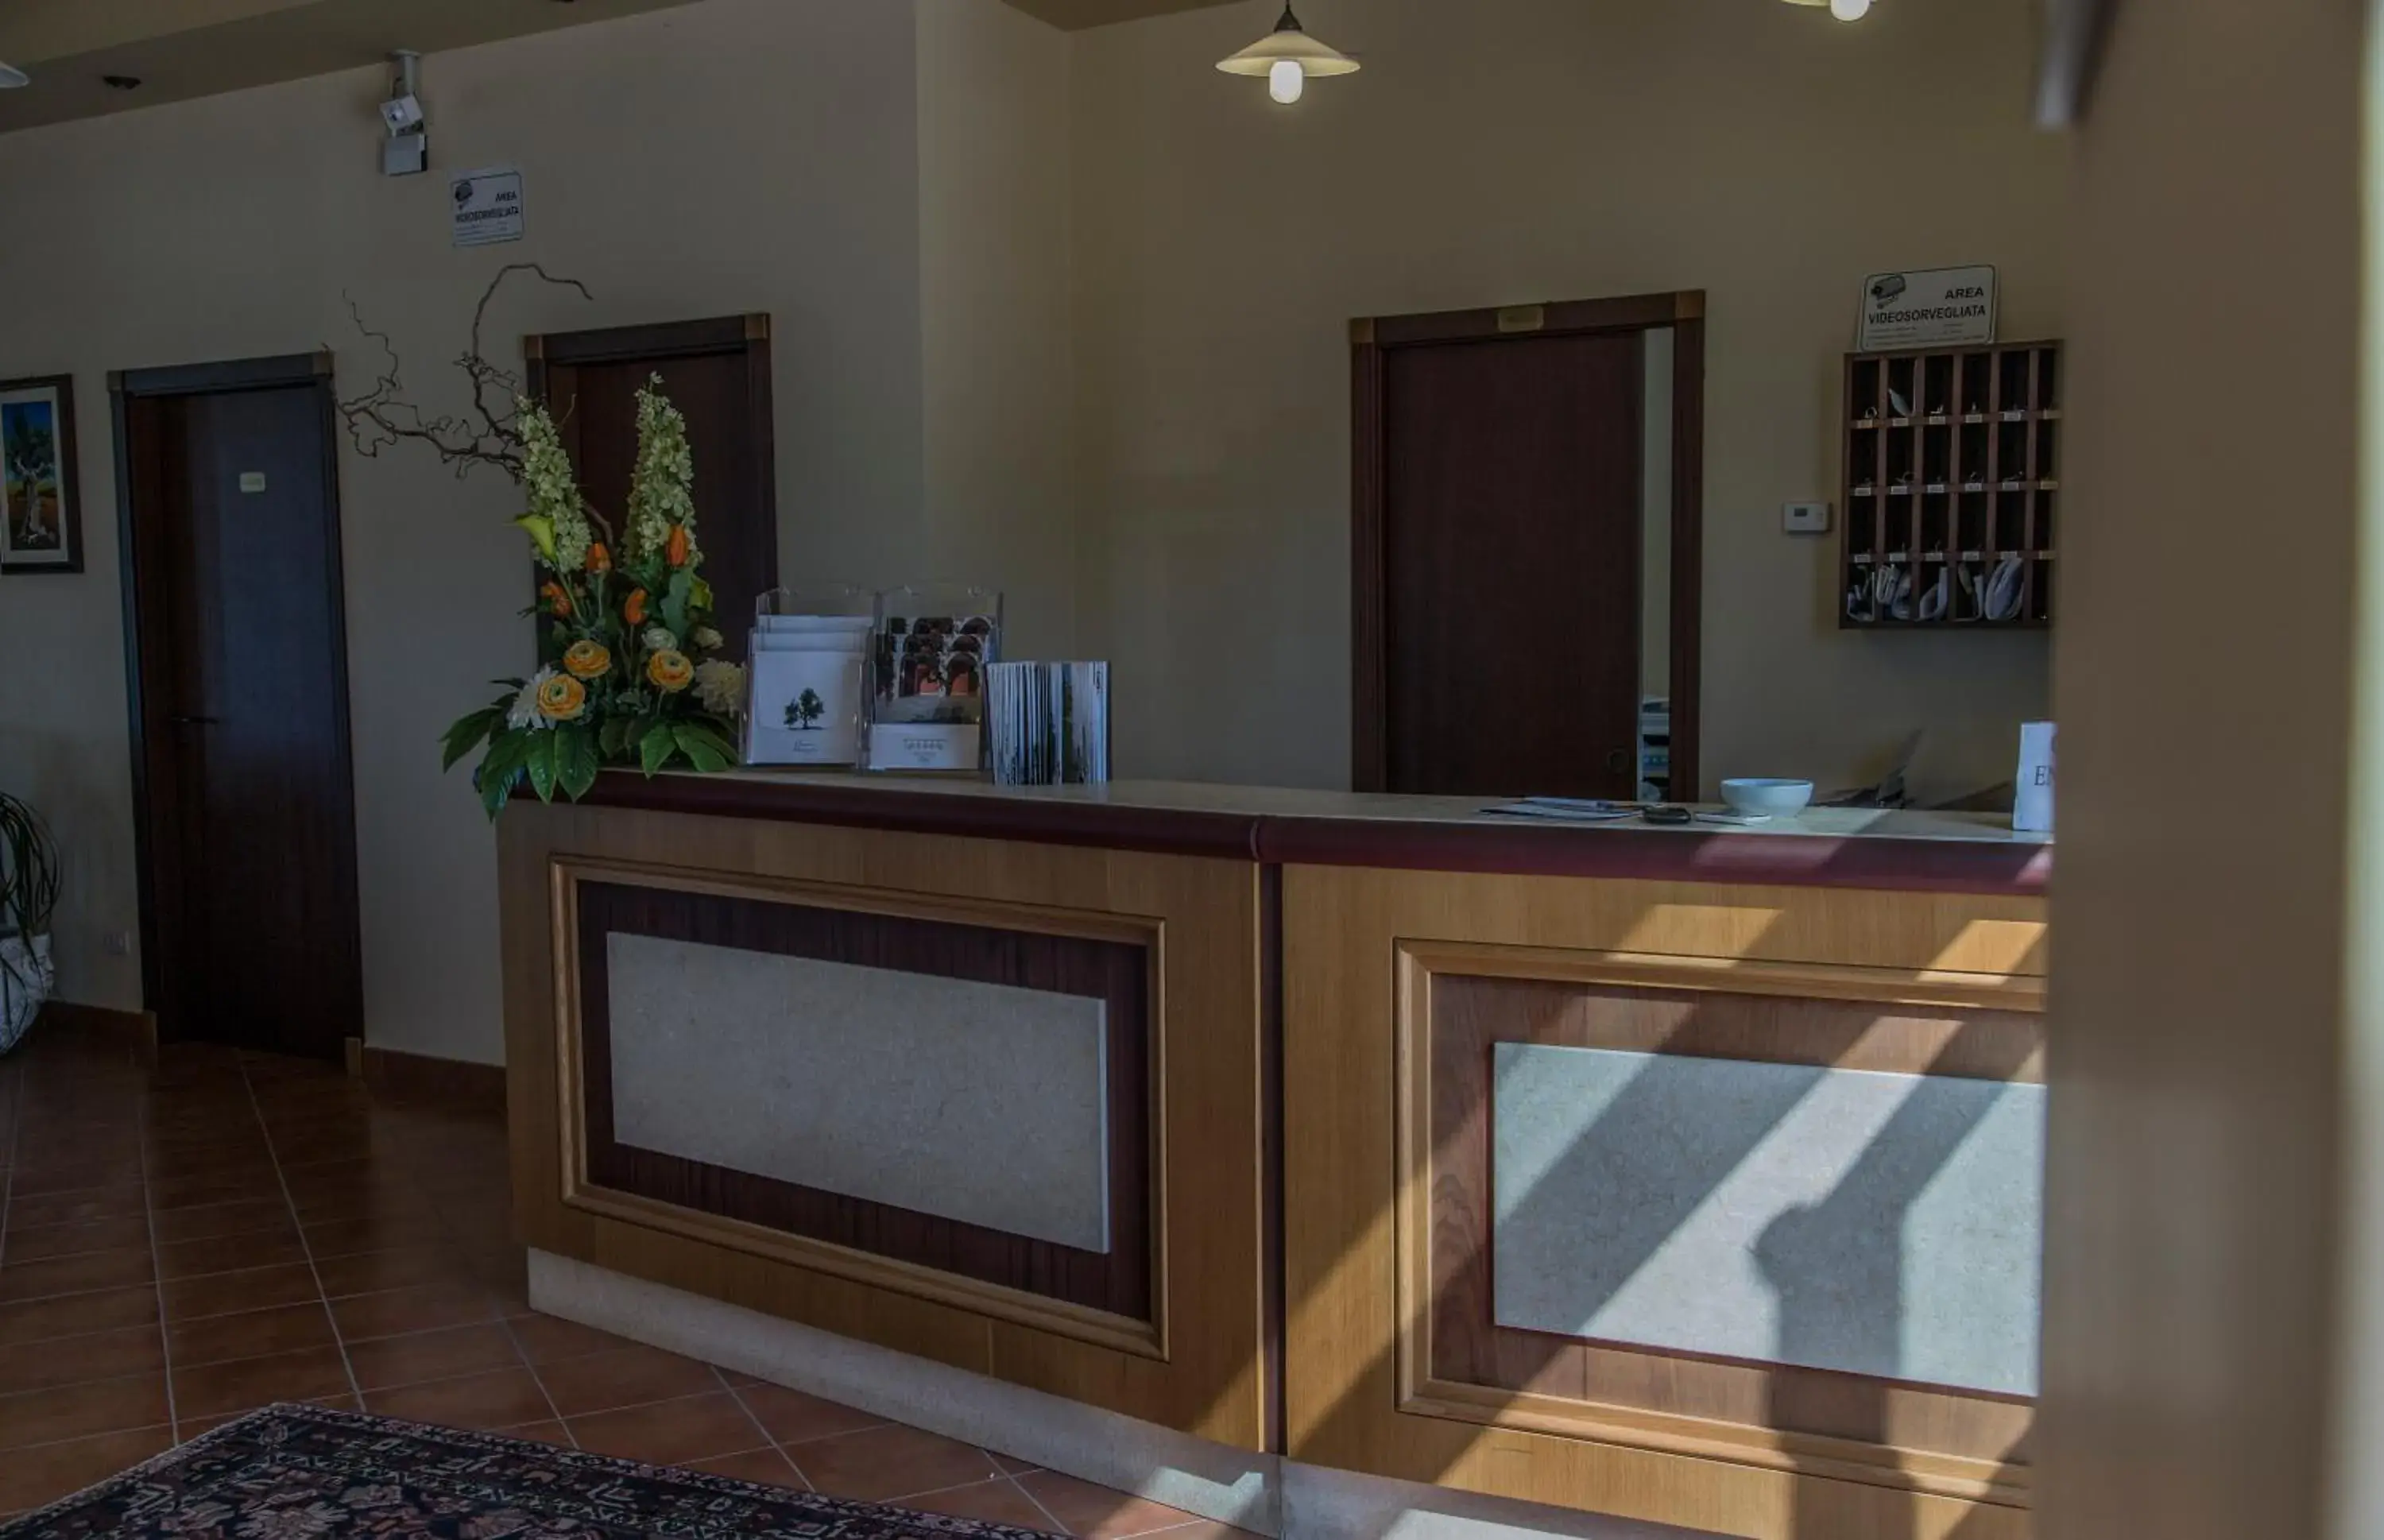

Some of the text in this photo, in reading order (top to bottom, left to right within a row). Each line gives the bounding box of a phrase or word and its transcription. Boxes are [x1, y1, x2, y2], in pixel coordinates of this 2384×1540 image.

[495, 191, 517, 202] AREA
[1945, 286, 1984, 300] AREA
[1868, 304, 1986, 324] VIDEOSORVEGLIATA
